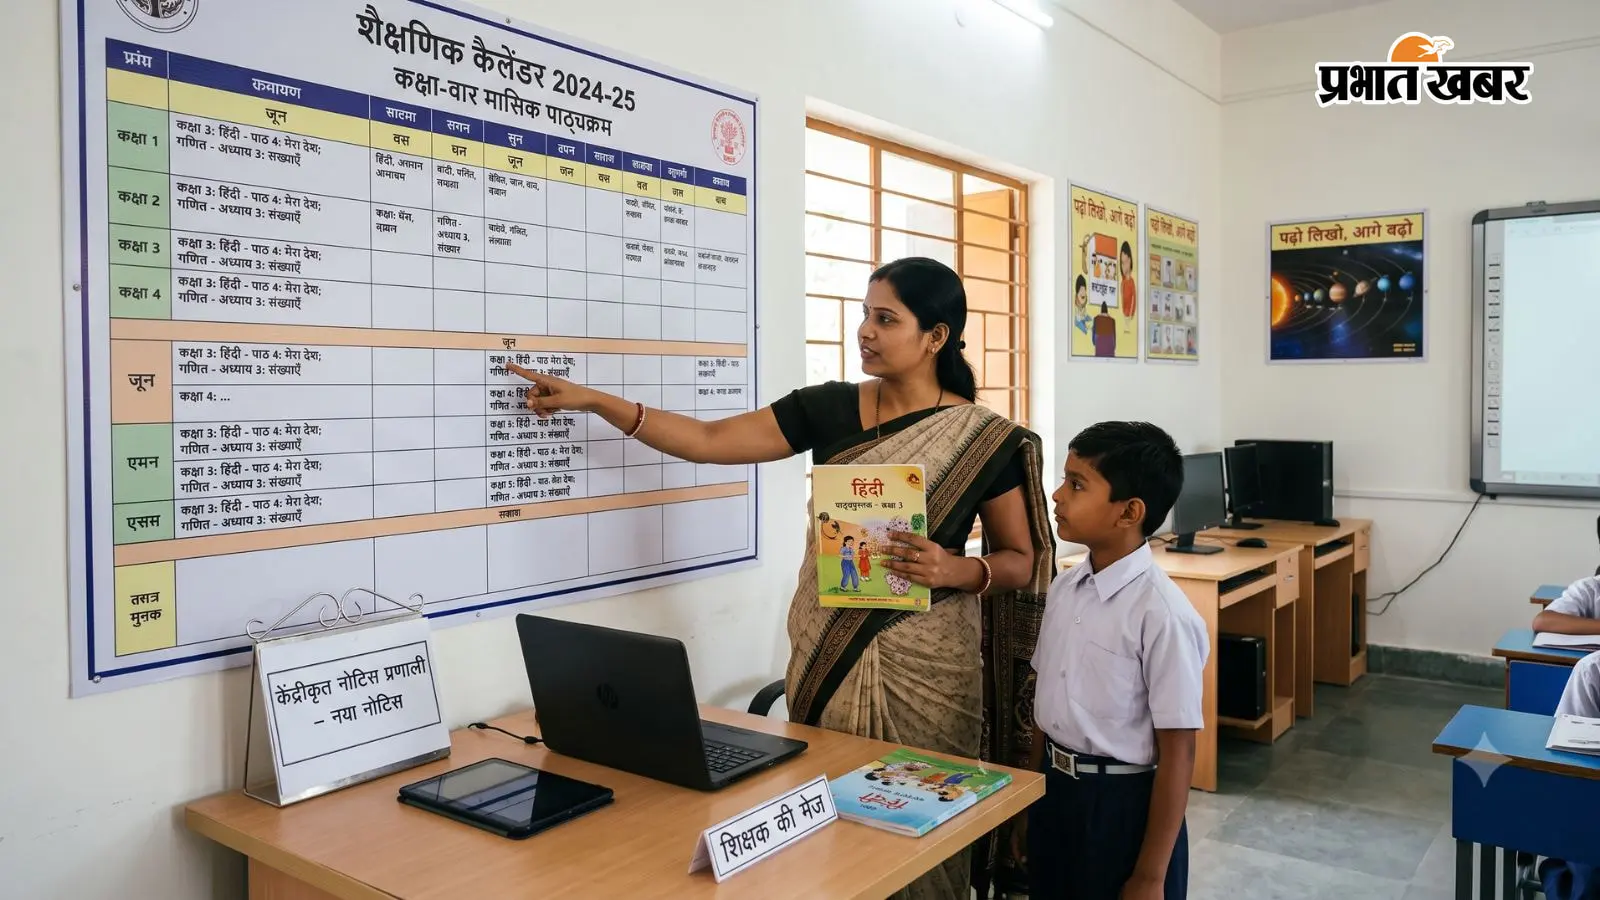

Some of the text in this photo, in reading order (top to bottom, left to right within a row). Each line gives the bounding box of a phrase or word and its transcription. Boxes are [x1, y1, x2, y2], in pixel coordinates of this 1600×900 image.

[356, 4, 635, 111] शैक्षणिक कैलेंडर 2024-25
[393, 67, 479, 105] कक्षा-वार
[483, 89, 541, 118] मासिक
[265, 108, 287, 125] जून
[117, 130, 157, 146] कक्षा 1
[176, 120, 201, 133] कक्षा
[205, 125, 214, 135] 3:
[218, 124, 240, 140] हिंदी
[250, 133, 269, 144] पाठ
[272, 137, 281, 146] 4:
[284, 136, 301, 150] मेरा
[176, 135, 207, 150] गणित
[255, 149, 264, 159] 3:
[508, 156, 523, 169] जून
[117, 191, 160, 206] कक्षा 2
[176, 182, 202, 195] कक्षा
[205, 186, 215, 196] 3:
[218, 185, 240, 200] हिंदी
[251, 192, 269, 203] पाठ
[272, 196, 281, 204] 4:
[284, 194, 301, 207] मेरा
[177, 197, 207, 211] गणित
[255, 208, 264, 218] 3:
[1280, 219, 1413, 246] पढ़ो लिखो, आगे बढ़ो
[118, 239, 160, 253] कक्षा 3
[177, 237, 202, 249] कक्षा
[206, 240, 215, 249] 3:
[219, 238, 241, 252] हिंदी
[251, 244, 269, 255] पाठ
[272, 247, 281, 255] 4:
[284, 245, 301, 257] मेरा
[177, 251, 208, 265] गणित
[256, 260, 265, 269] 3:
[178, 277, 202, 288] कक्षा
[206, 278, 216, 288] 3:
[219, 276, 241, 290] हिंदी
[251, 281, 269, 291] पाठ
[272, 283, 281, 291] 4:
[284, 281, 301, 293] मेरा
[118, 287, 161, 300] कक्षा 4
[178, 290, 208, 303] गणित
[256, 297, 265, 306] 3:
[503, 338, 516, 349] जून
[178, 348, 203, 359] कक्षा
[207, 349, 216, 358] 3:
[220, 346, 241, 360] हिंदी
[252, 350, 270, 359] पाठ
[273, 350, 281, 359] 4:
[284, 348, 301, 359] मेरा
[179, 361, 208, 374] गणित
[256, 365, 265, 374] 3:
[128, 374, 155, 392] जून
[179, 392, 203, 402] कक्षा
[207, 392, 216, 401] 4:
[127, 456, 159, 471] एमन
[850, 478, 885, 498] हिंदी
[180, 505, 205, 516] कक्षा
[208, 504, 217, 513] 3:
[220, 499, 242, 513] हिंदी
[252, 500, 270, 509] पाठ
[273, 499, 282, 507] 4:
[285, 495, 302, 506] मेरा
[126, 515, 160, 531] एसस
[181, 518, 210, 531] गणित
[257, 516, 265, 524] 3:
[275, 655, 426, 705] केंद्रीकृत नोटिस प्रणाली
[330, 694, 403, 724] नया नोटिस
[720, 794, 825, 862] शिक्षक की मेज
